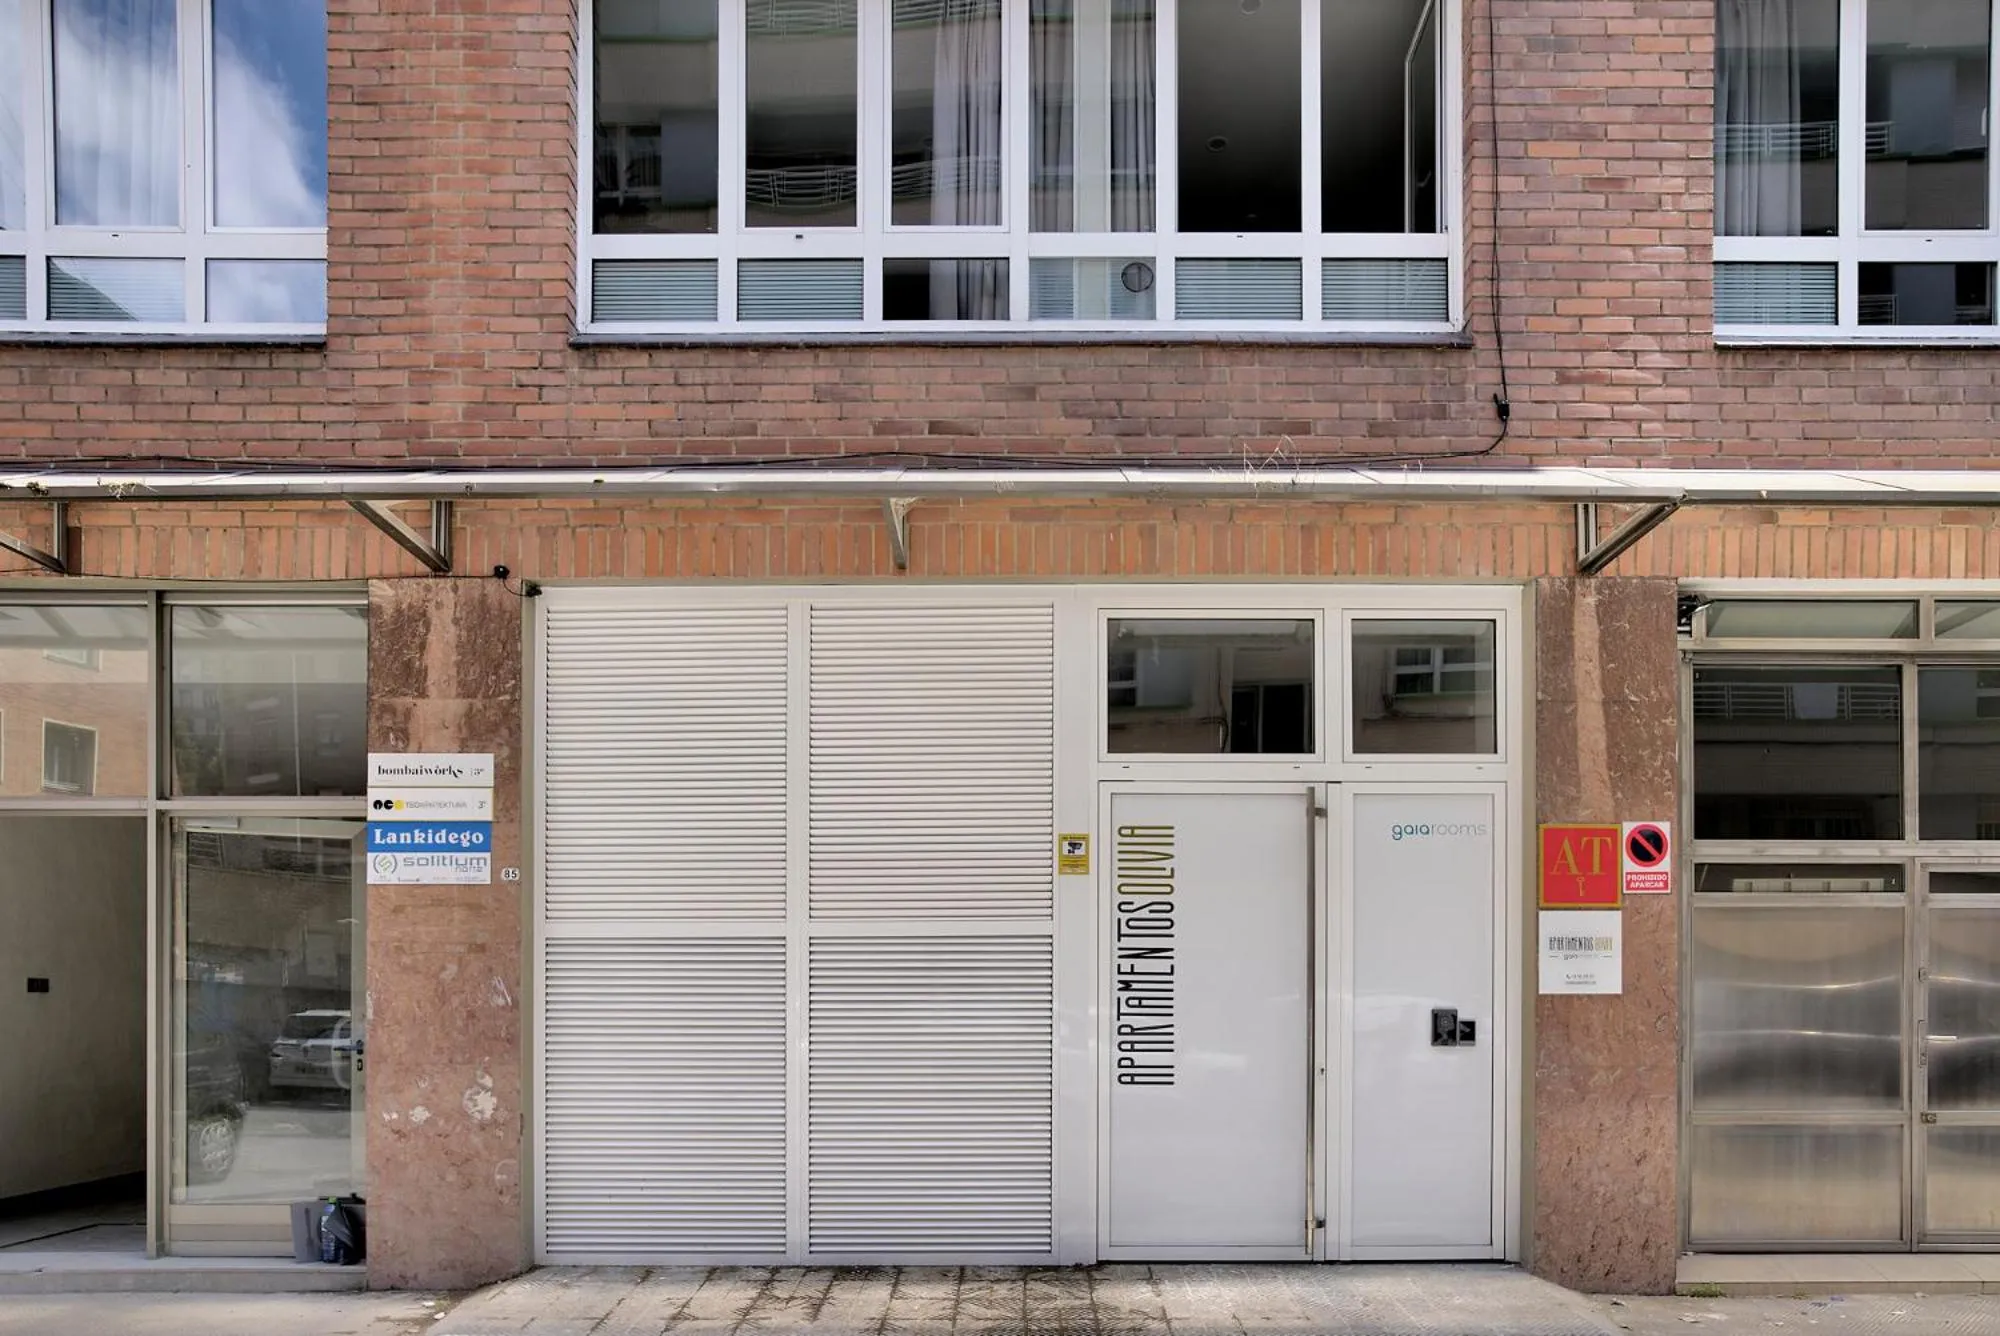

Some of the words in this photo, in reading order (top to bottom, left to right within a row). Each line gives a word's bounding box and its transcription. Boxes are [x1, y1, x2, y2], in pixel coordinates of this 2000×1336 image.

[374, 828, 484, 847] Lankidego
[1392, 824, 1487, 840] gaiarooms
[403, 855, 487, 867] solitium
[1117, 826, 1175, 895] OLIVIA
[1550, 836, 1613, 876] AT
[504, 869, 518, 879] 85
[1630, 881, 1665, 889] APARCAR
[1117, 901, 1175, 1085] APARTAMENTOS
